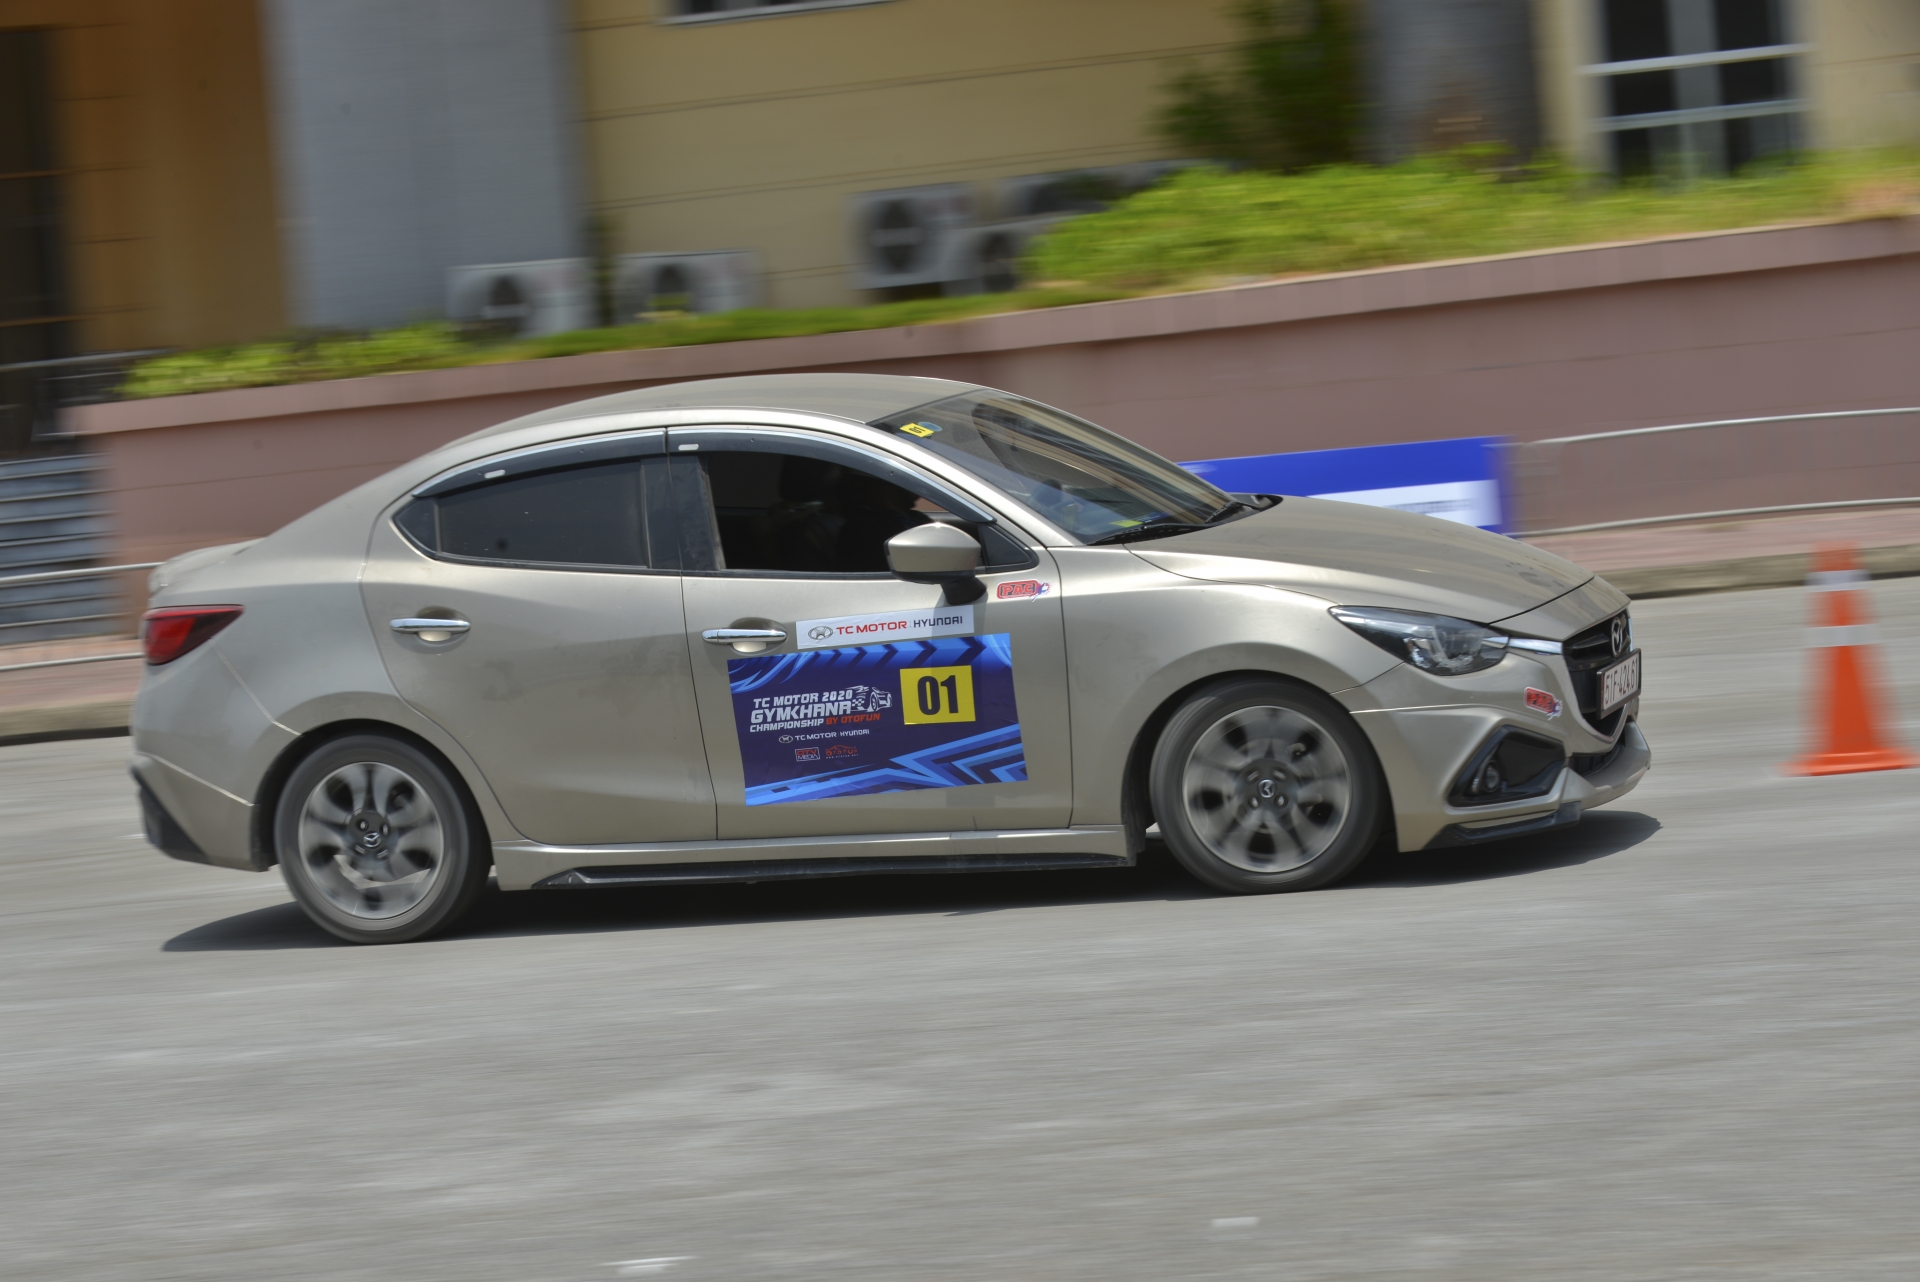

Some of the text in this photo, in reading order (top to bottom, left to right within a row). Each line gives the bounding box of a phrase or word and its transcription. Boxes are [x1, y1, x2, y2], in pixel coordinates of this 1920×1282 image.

[1001, 583, 1034, 596] PAC
[836, 616, 963, 635] TC MOTOR HYUNDAI
[753, 690, 853, 708] TC MOTOR 2020
[917, 674, 958, 716] 01
[751, 701, 852, 723] GYMKHANA
[750, 713, 880, 732] CHAMPIONSHIP BY OTOFUN
[807, 732, 837, 740] MOTOR
[840, 729, 870, 737] HYUNDAI
